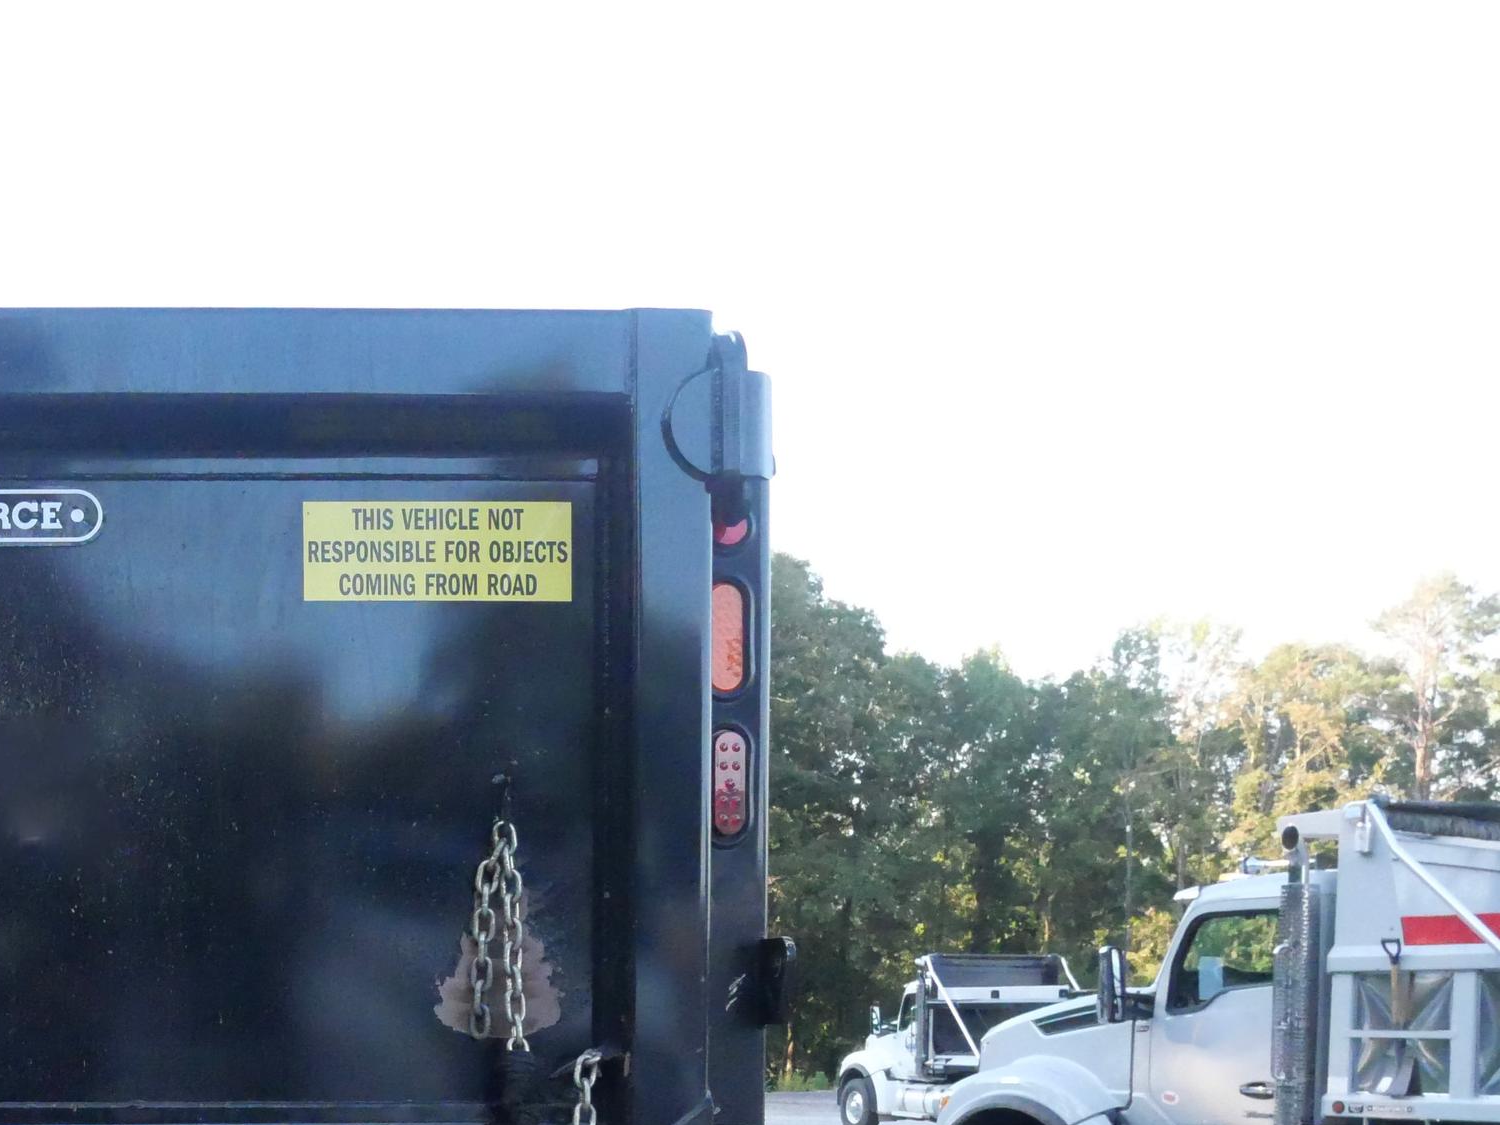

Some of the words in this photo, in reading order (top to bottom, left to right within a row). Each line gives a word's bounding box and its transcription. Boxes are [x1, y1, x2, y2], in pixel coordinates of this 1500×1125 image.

[351, 508, 394, 531] THIS
[401, 508, 479, 530] VEHICLE
[488, 508, 524, 530] NOT
[307, 540, 436, 563] RESPONSIBLE
[444, 540, 481, 563] FOR
[488, 540, 569, 563] OBJECTS
[338, 573, 416, 596] COMING
[425, 573, 478, 596] FROM
[487, 573, 538, 596] ROAD
